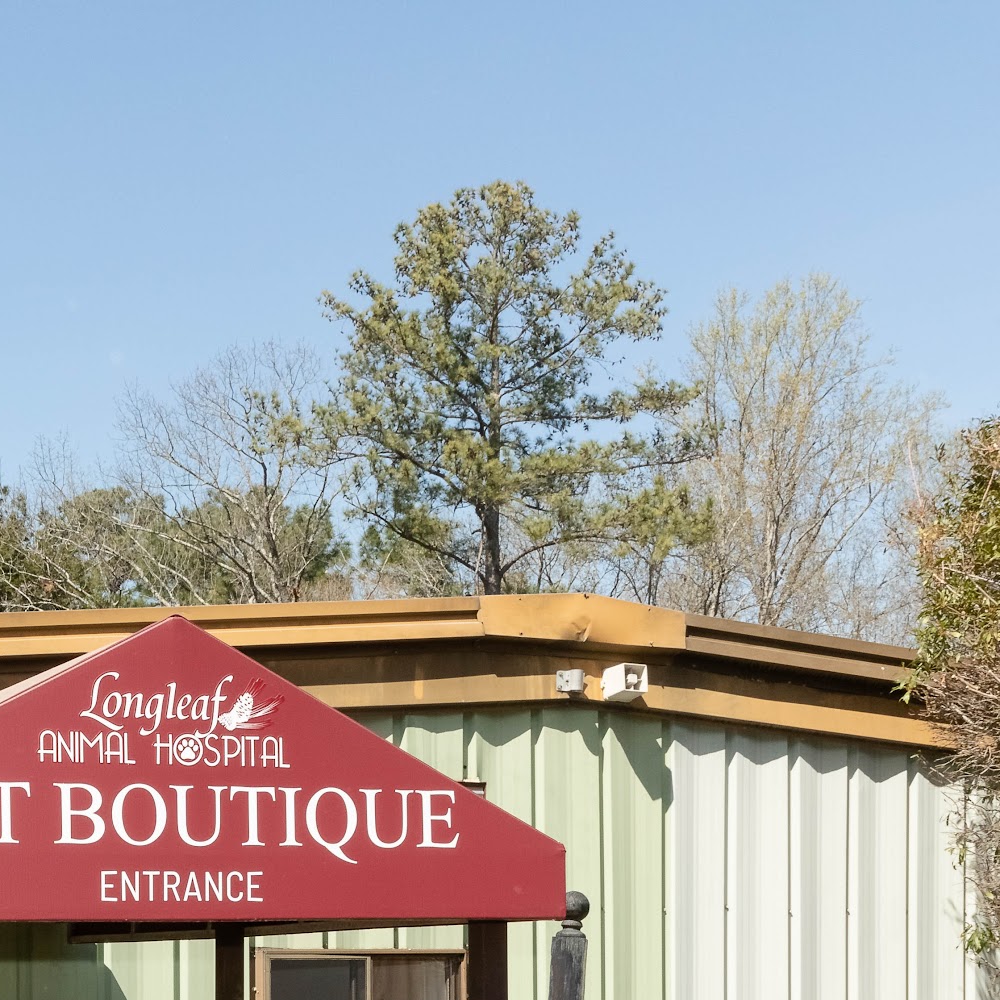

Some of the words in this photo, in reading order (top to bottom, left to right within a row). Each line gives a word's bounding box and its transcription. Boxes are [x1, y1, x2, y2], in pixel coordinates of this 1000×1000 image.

[79, 671, 234, 740] Longleaf
[37, 729, 137, 766] ANIMAL
[152, 732, 292, 769] HOSPITAL
[52, 782, 461, 865] BOUTIQUE
[100, 870, 264, 903] ENTRANCE
